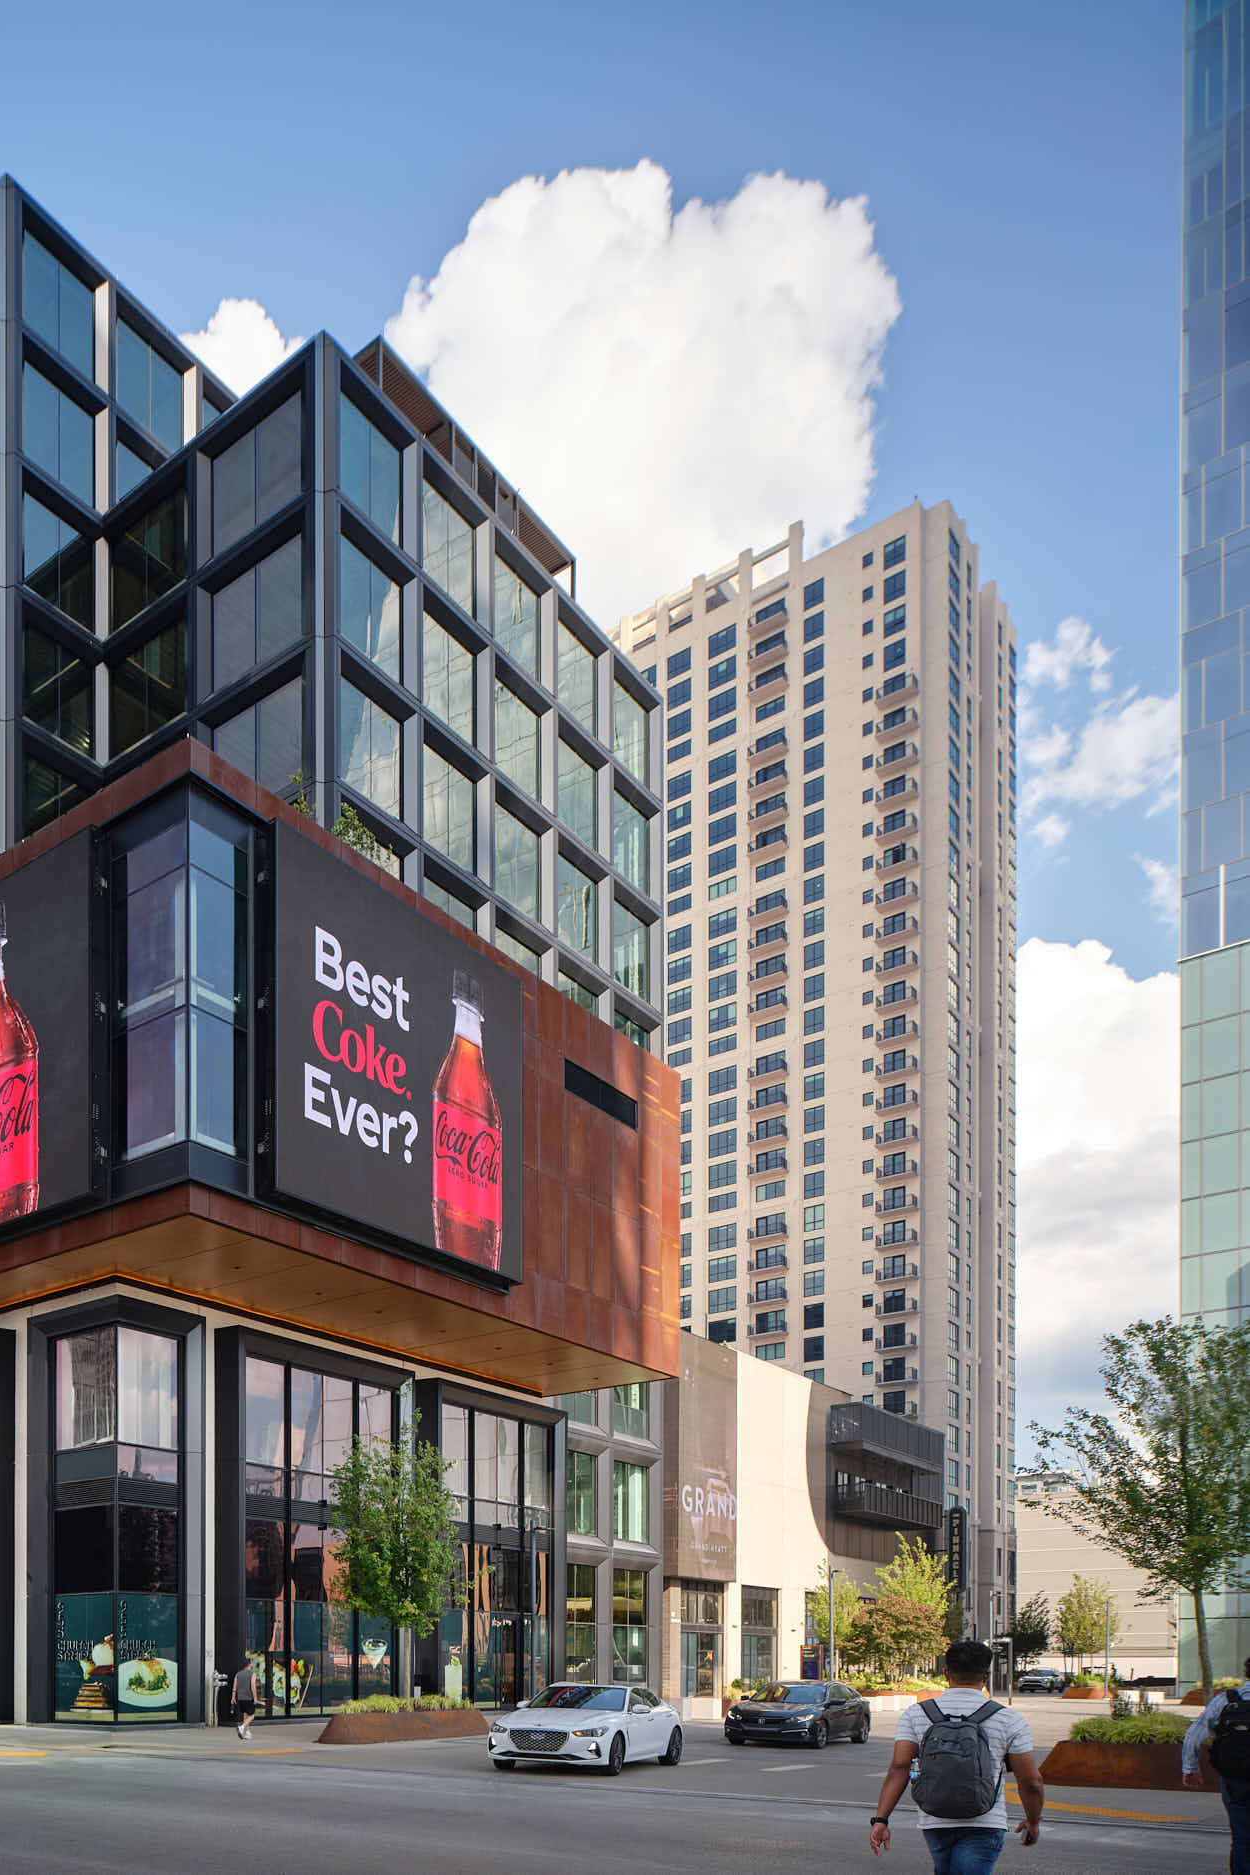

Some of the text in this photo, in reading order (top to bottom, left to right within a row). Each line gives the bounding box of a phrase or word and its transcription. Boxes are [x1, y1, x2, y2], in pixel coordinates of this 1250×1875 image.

[315, 925, 410, 1032] Best
[304, 1062, 419, 1164] Ever?
[682, 1484, 737, 1520] GRAND
